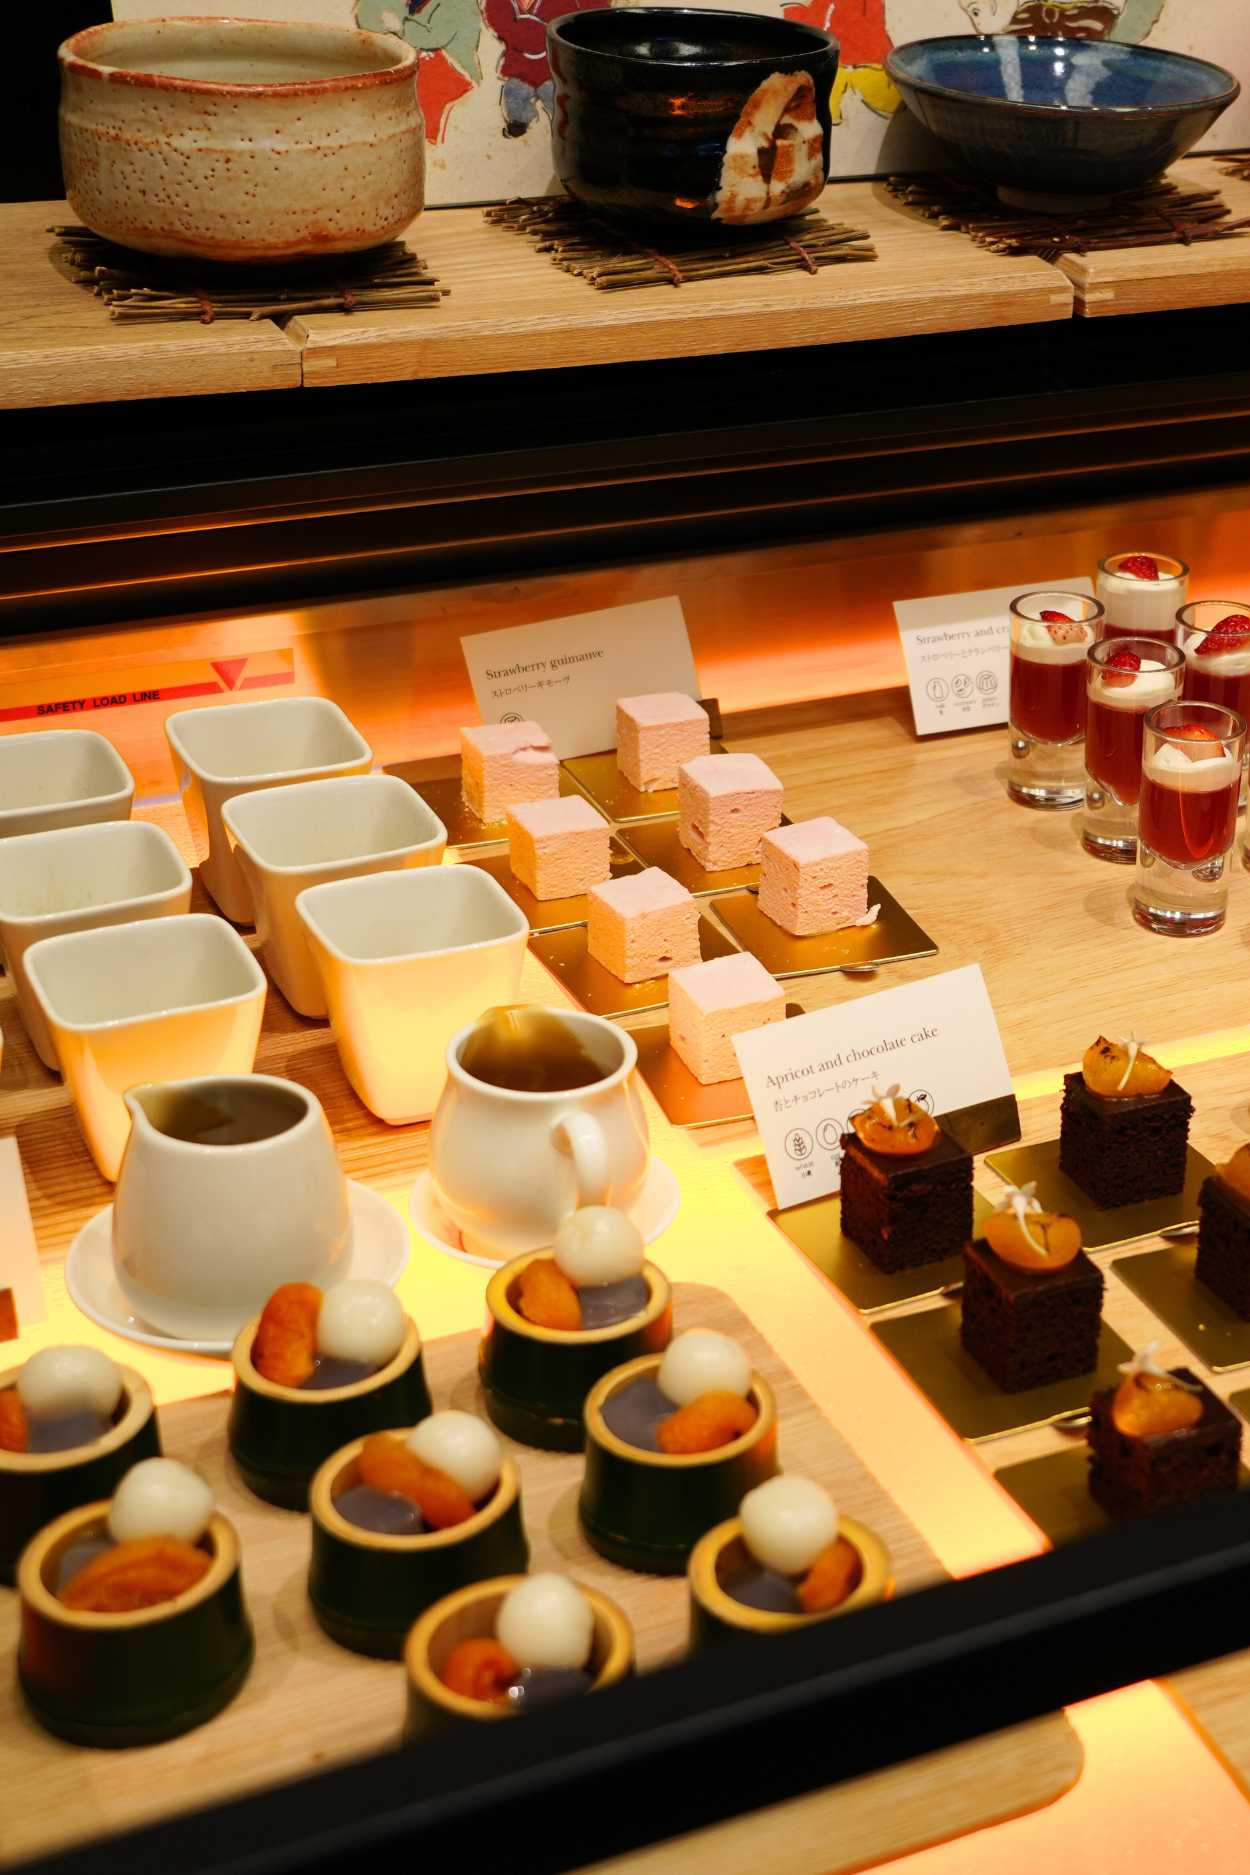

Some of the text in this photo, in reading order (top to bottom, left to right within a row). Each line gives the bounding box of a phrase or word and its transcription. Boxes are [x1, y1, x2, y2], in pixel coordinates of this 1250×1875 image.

[916, 631, 971, 645] Strawberry
[974, 626, 994, 637] and
[486, 650, 605, 680] Strawberry guimauve
[36, 689, 160, 716] SAFETY LOAD LINE
[765, 1026, 940, 1090] Apricot and chocolate cake
